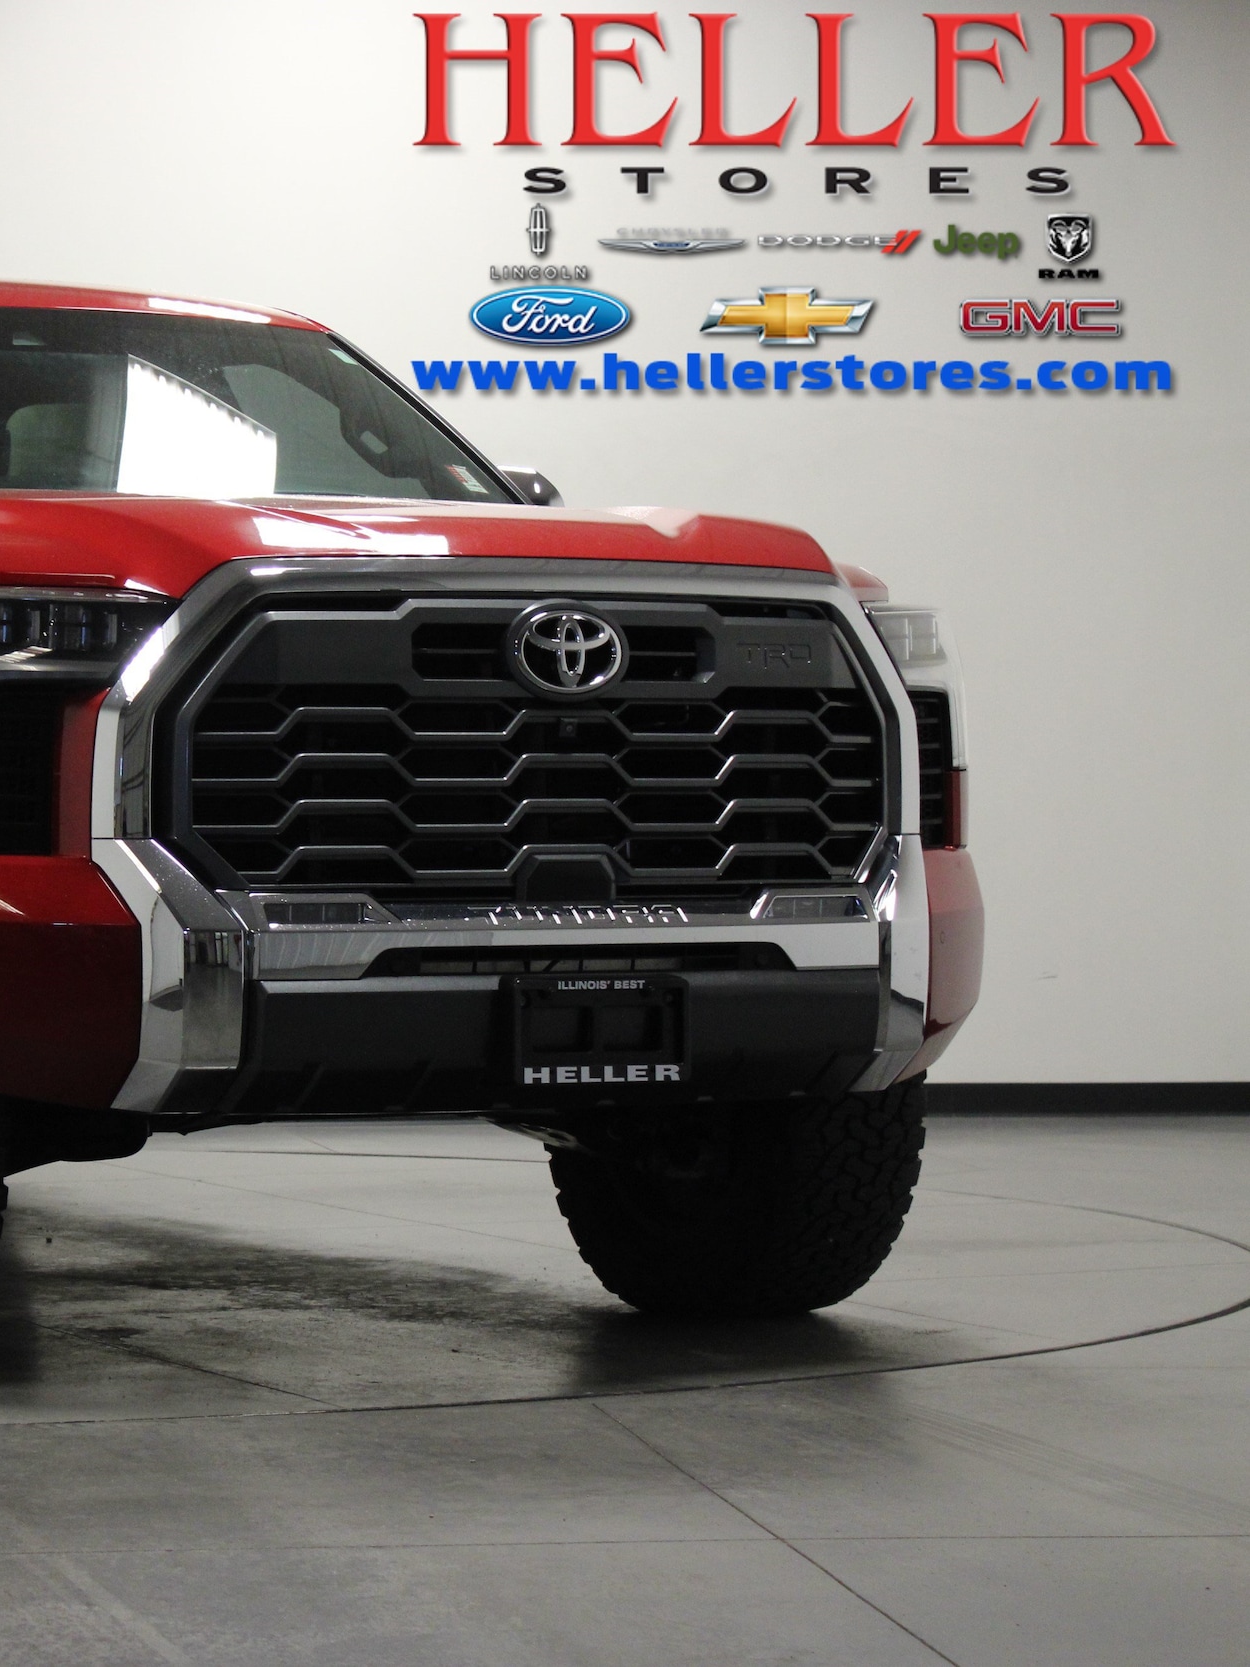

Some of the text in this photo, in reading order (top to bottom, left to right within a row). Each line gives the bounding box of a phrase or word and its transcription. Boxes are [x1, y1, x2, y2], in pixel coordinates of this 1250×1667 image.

[557, 980, 645, 990] ILLINOIS' BEST
[524, 1064, 681, 1084] HELLER
